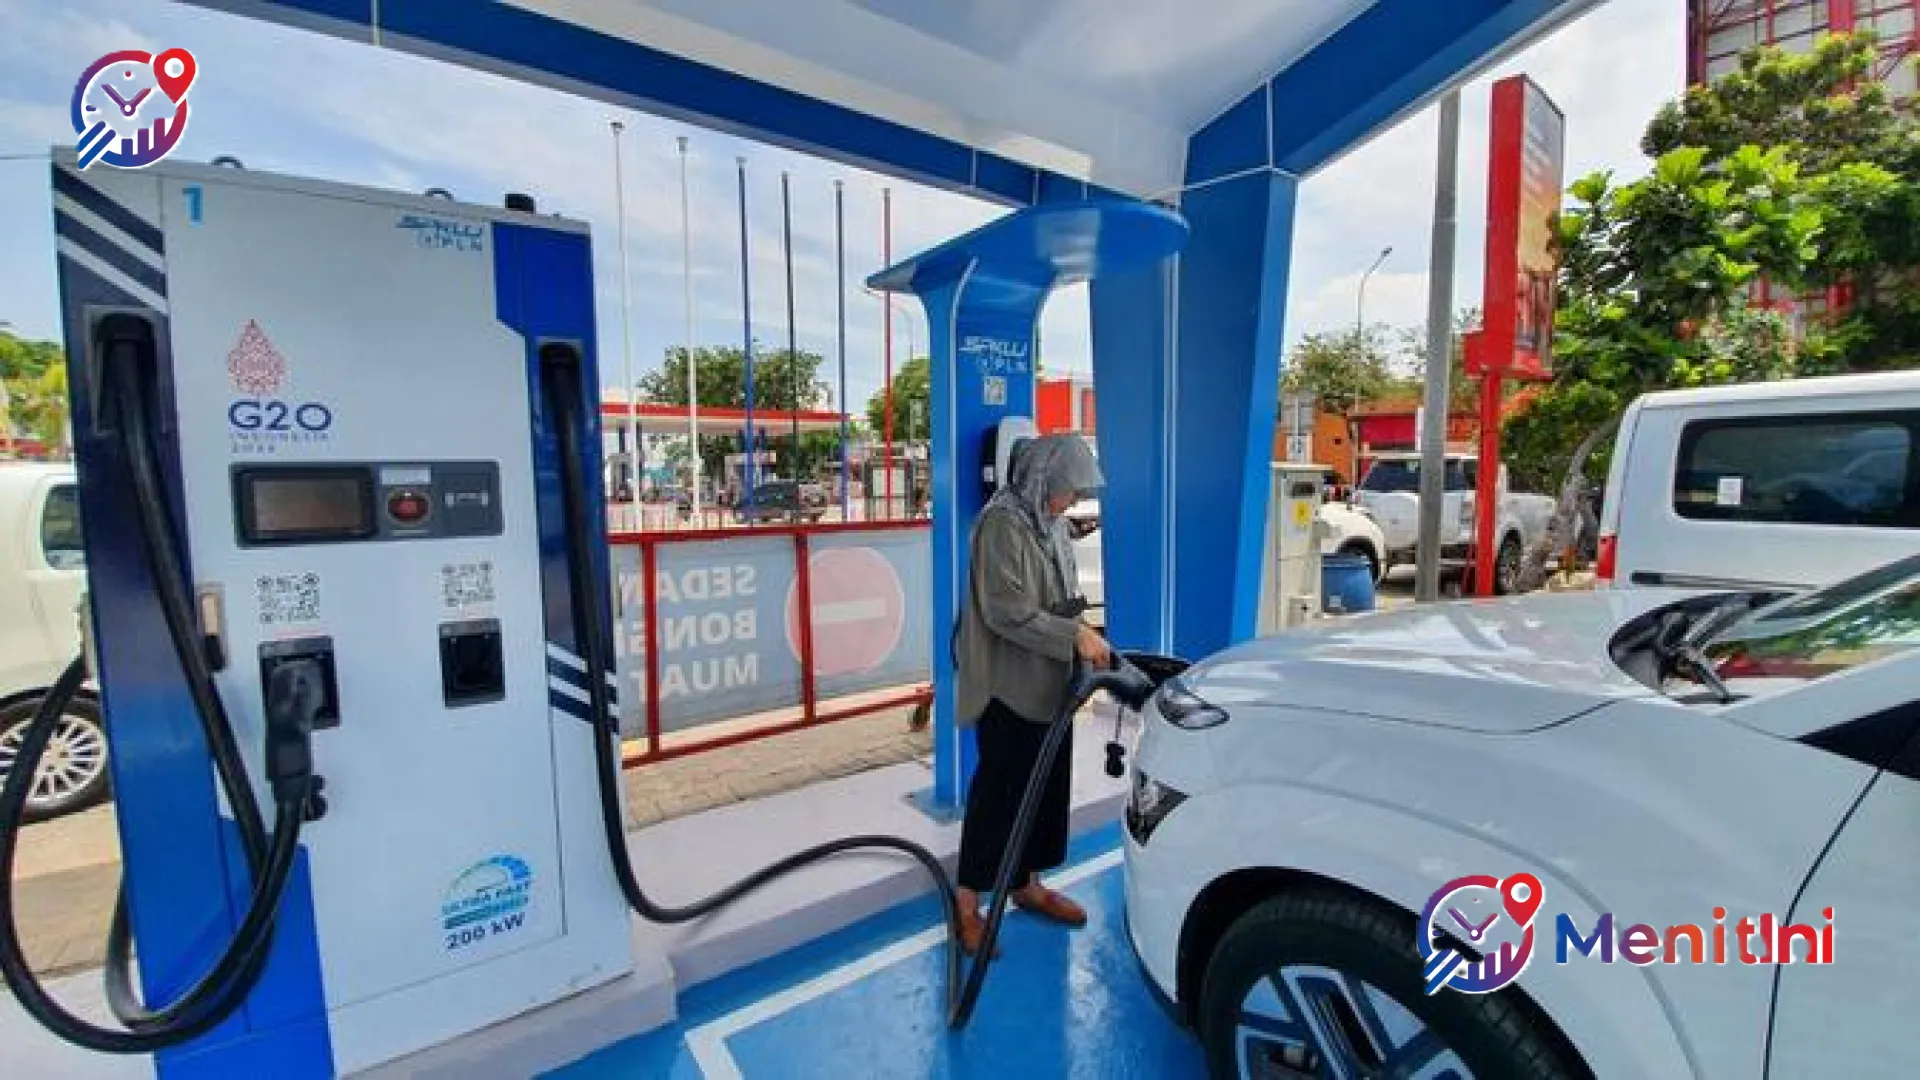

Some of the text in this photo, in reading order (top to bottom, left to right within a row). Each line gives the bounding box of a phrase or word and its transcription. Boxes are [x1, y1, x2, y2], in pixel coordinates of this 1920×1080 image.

[182, 185, 204, 224] 1
[444, 925, 486, 951] 200
[490, 911, 526, 935] kW
